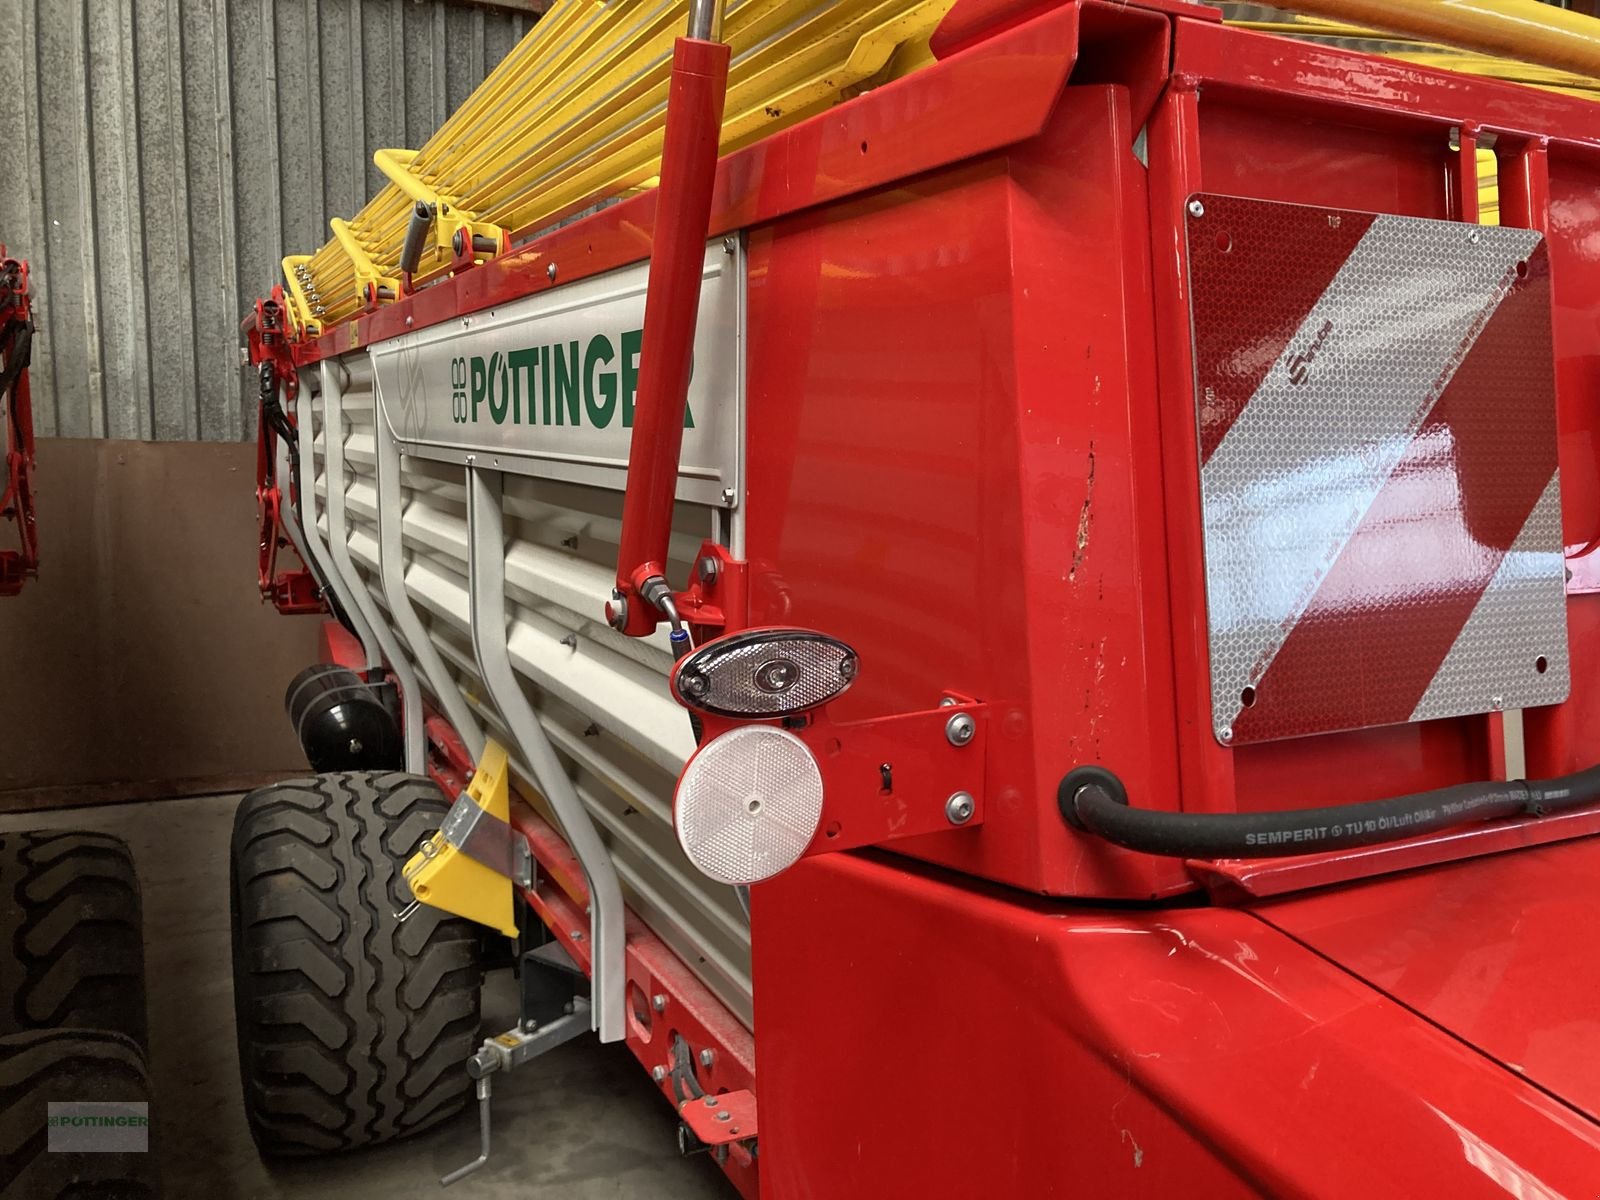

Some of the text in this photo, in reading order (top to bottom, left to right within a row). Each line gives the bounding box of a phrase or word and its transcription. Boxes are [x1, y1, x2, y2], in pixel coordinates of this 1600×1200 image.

[470, 328, 696, 430] PÖTTINGE
[1245, 826, 1328, 847] SEMPERIT
[1346, 822, 1364, 838] TU
